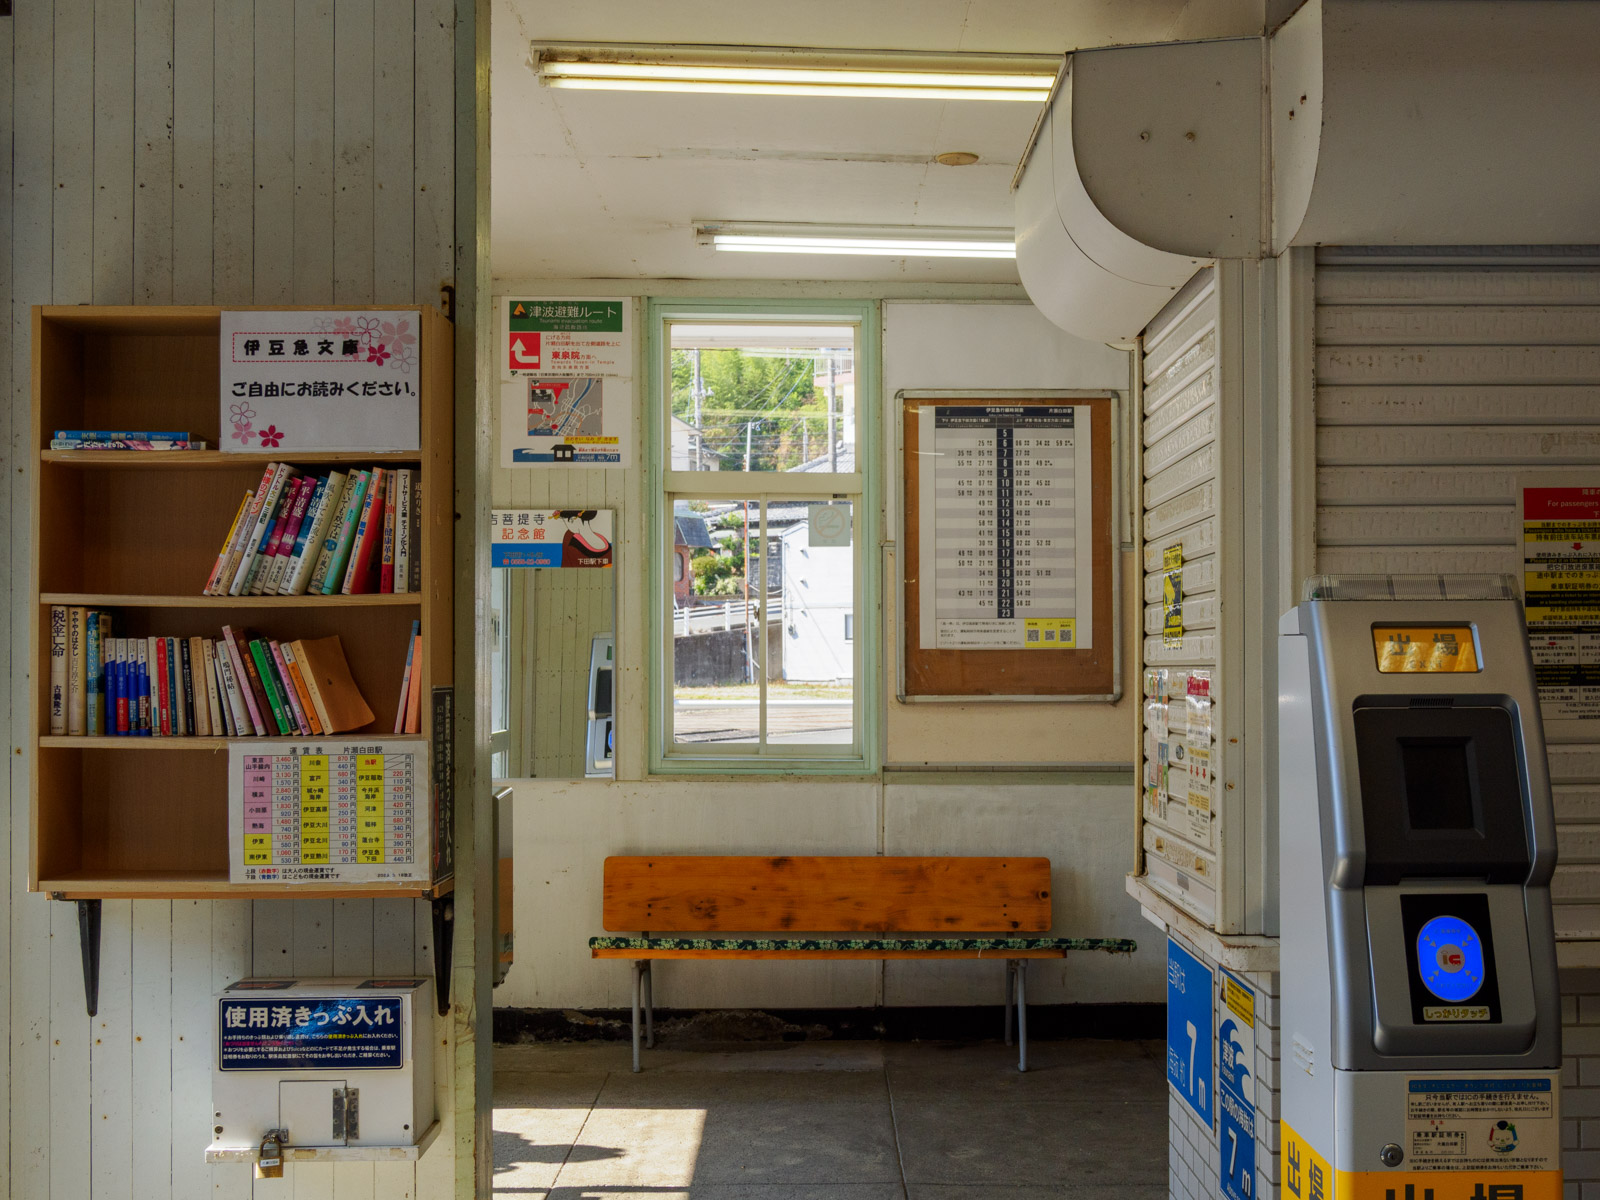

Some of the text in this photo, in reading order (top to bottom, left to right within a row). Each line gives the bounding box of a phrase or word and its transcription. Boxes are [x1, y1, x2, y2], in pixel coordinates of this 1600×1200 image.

[529, 305, 616, 318] 津波避難ルート
[244, 339, 359, 356] 伊豆急文庫
[232, 381, 416, 397] ご自由にお読みください。
[1003, 439, 1007, 447] 6
[1003, 449, 1007, 457] 7
[1003, 459, 1007, 467] 8
[1003, 469, 1007, 477] 9
[1002, 479, 1010, 487] 10
[1002, 489, 1010, 497] 11
[1002, 499, 1010, 507] 12
[1560, 500, 1599, 508] passengers
[1002, 509, 1010, 517] 13
[1002, 519, 1010, 527] 14
[502, 528, 545, 540] 記念館
[1002, 529, 1010, 537] 15
[1002, 539, 1010, 547] 16
[1002, 549, 1010, 557] 17
[1002, 559, 1010, 567] 18
[1002, 569, 1010, 577] 19
[1002, 579, 1010, 587] 20
[1002, 589, 1010, 597] 21
[1002, 599, 1010, 607] 22
[1002, 609, 1010, 617] 23
[52, 610, 66, 658] 税金亡命
[71, 611, 79, 657] やややのはなし
[1389, 633, 1459, 656] 出場
[290, 746, 383, 755] 運賃表 片瀬白田駅
[225, 1005, 394, 1028] 使用済きっぷ入れ
[1425, 1008, 1488, 1019] しっかりタッチ
[1222, 1039, 1235, 1070] 津波
[1186, 1020, 1206, 1111] 7 m
[1220, 1091, 1254, 1139] この駅の海抜は
[1228, 1126, 1251, 1197] 7 m
